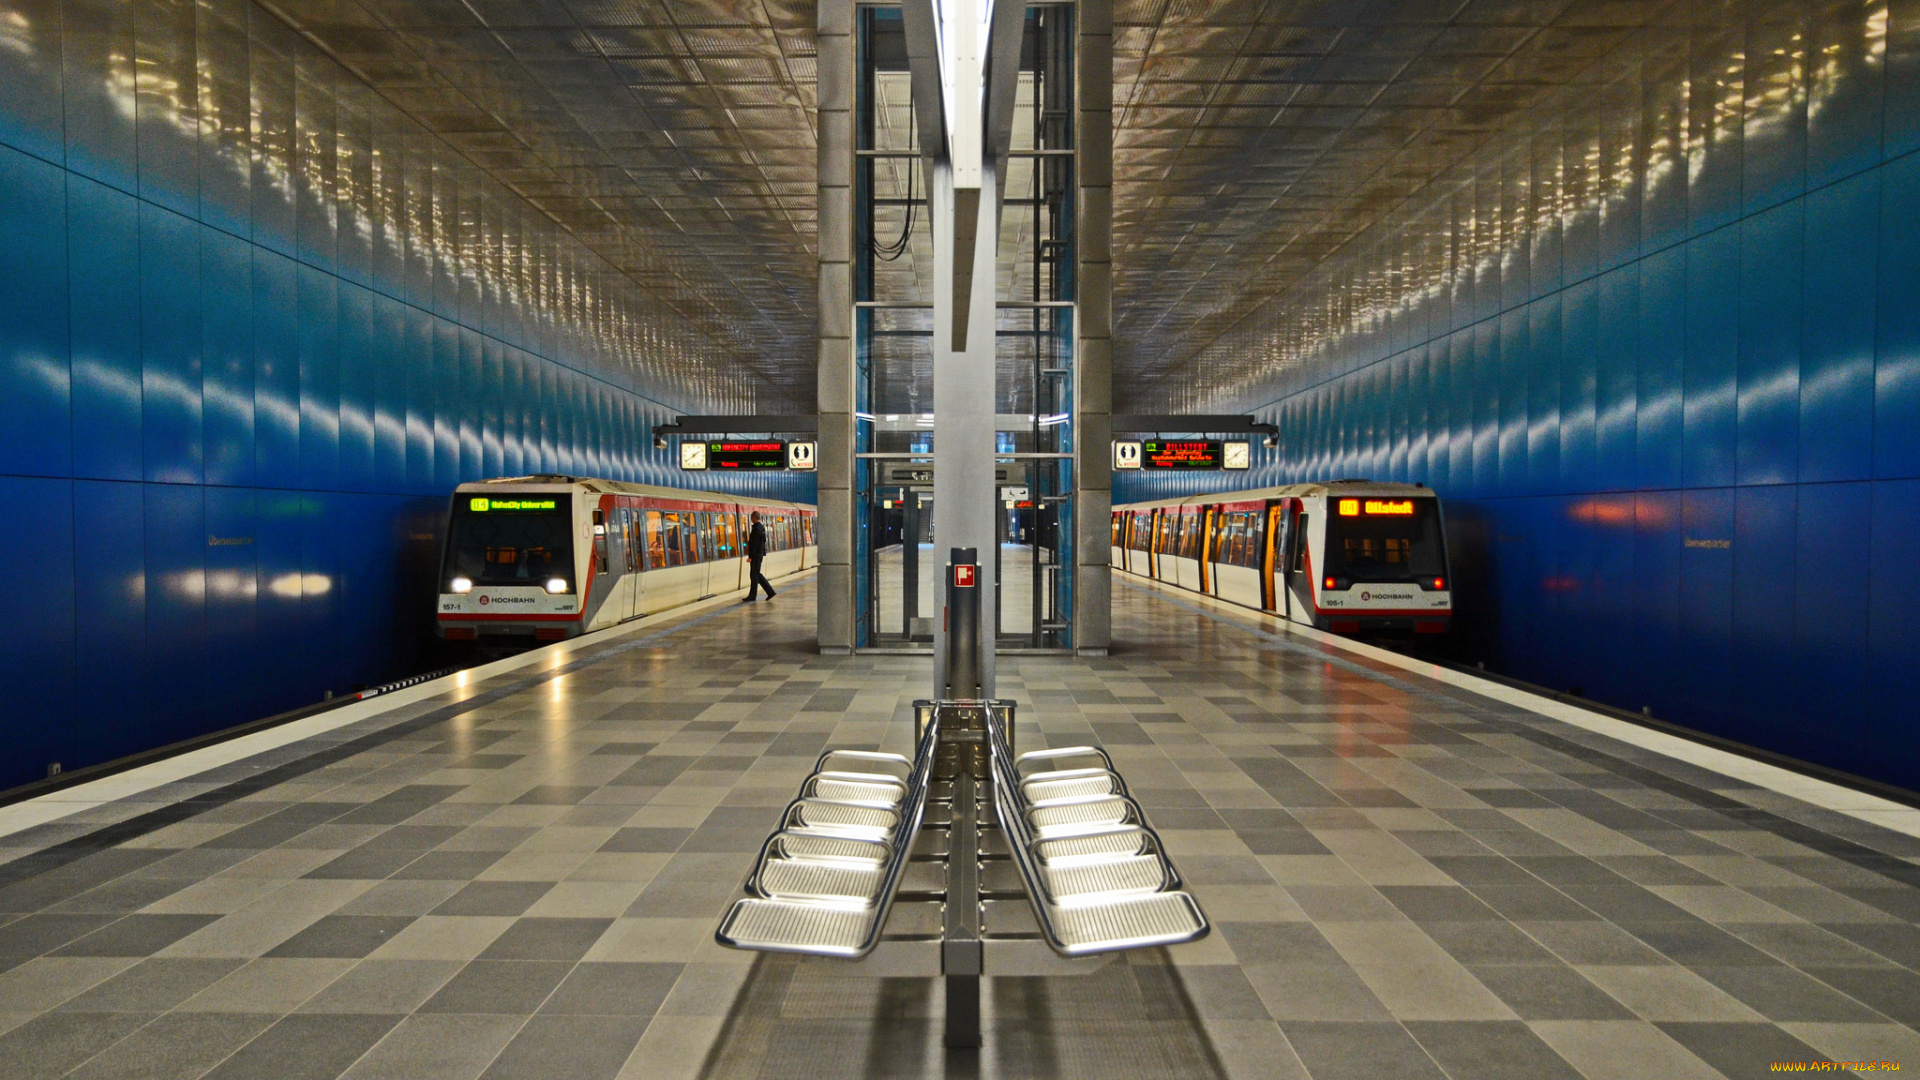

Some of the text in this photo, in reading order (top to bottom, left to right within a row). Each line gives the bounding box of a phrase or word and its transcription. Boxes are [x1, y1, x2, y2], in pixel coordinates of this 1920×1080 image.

[472, 499, 487, 510] U4
[1341, 500, 1413, 514] U4 Billstedt
